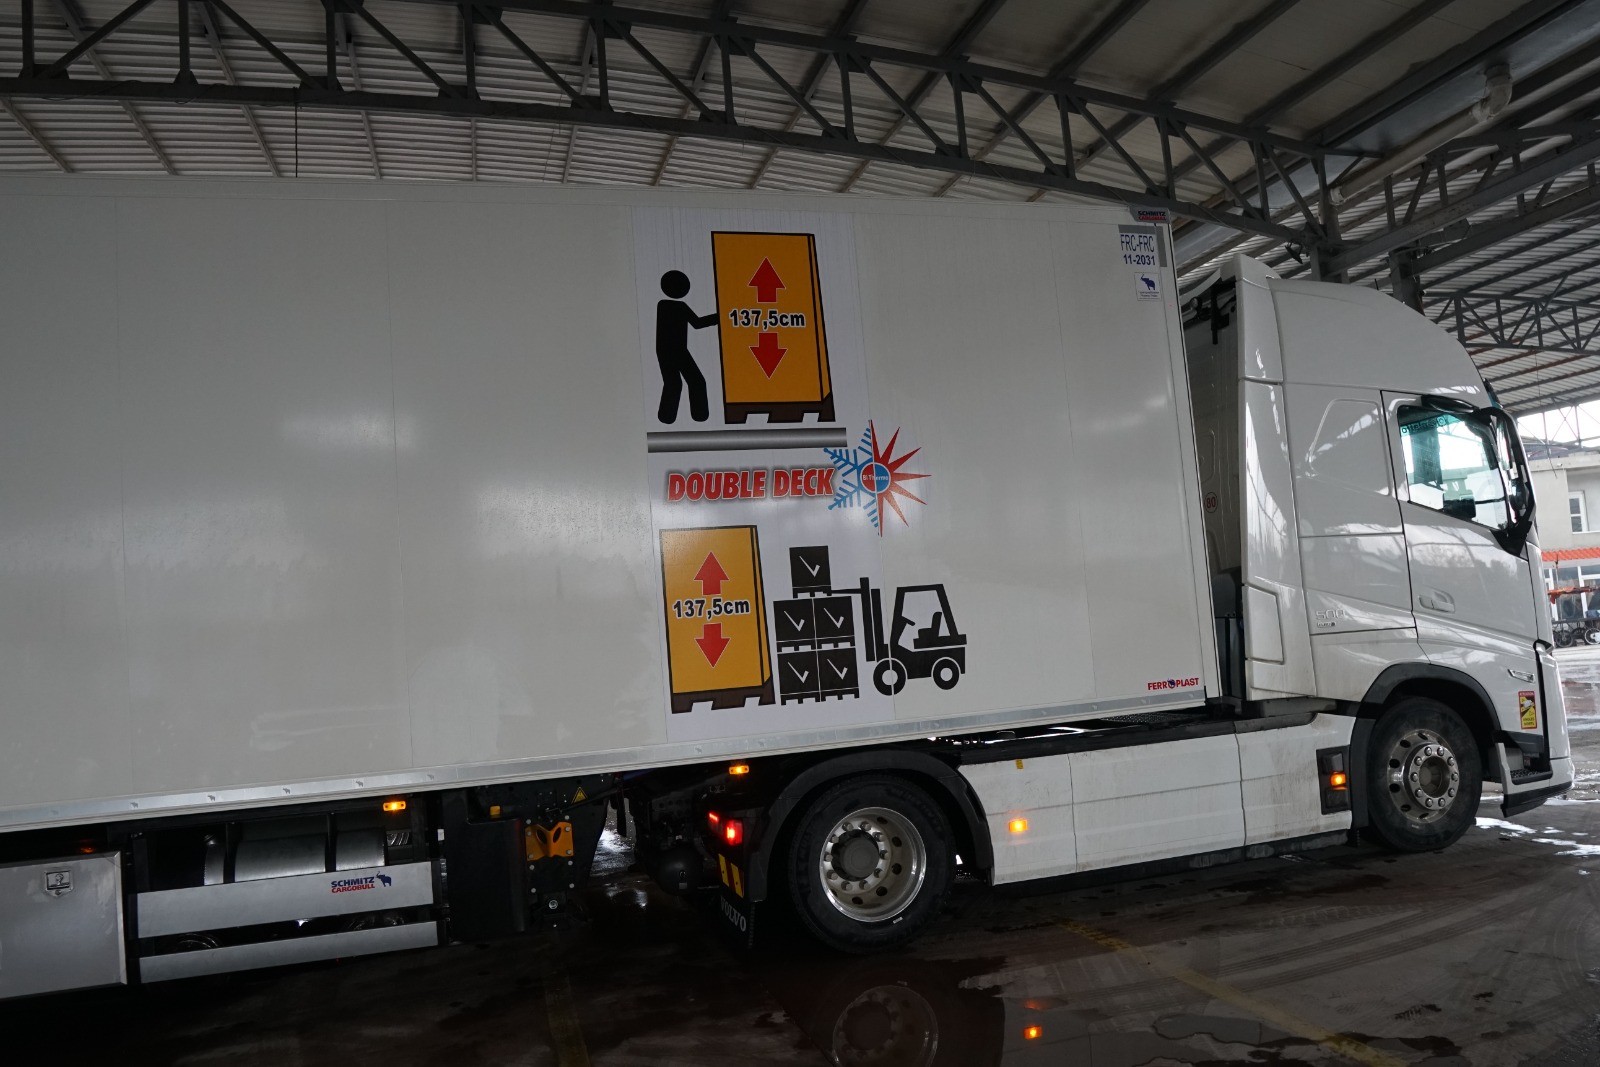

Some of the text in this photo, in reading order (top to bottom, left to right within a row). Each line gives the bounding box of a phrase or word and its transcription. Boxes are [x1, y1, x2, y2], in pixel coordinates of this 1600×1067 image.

[1120, 234, 1155, 252] FRC-FRC
[1123, 254, 1155, 265] 11-2031
[729, 308, 805, 331] 137,5cm
[667, 468, 835, 501] DOUBLE DECK
[673, 597, 750, 620] 137,5cm
[331, 876, 375, 888] SCHMITZ
[331, 883, 376, 894] CARGOBULL
[720, 895, 747, 932] VOLVO
